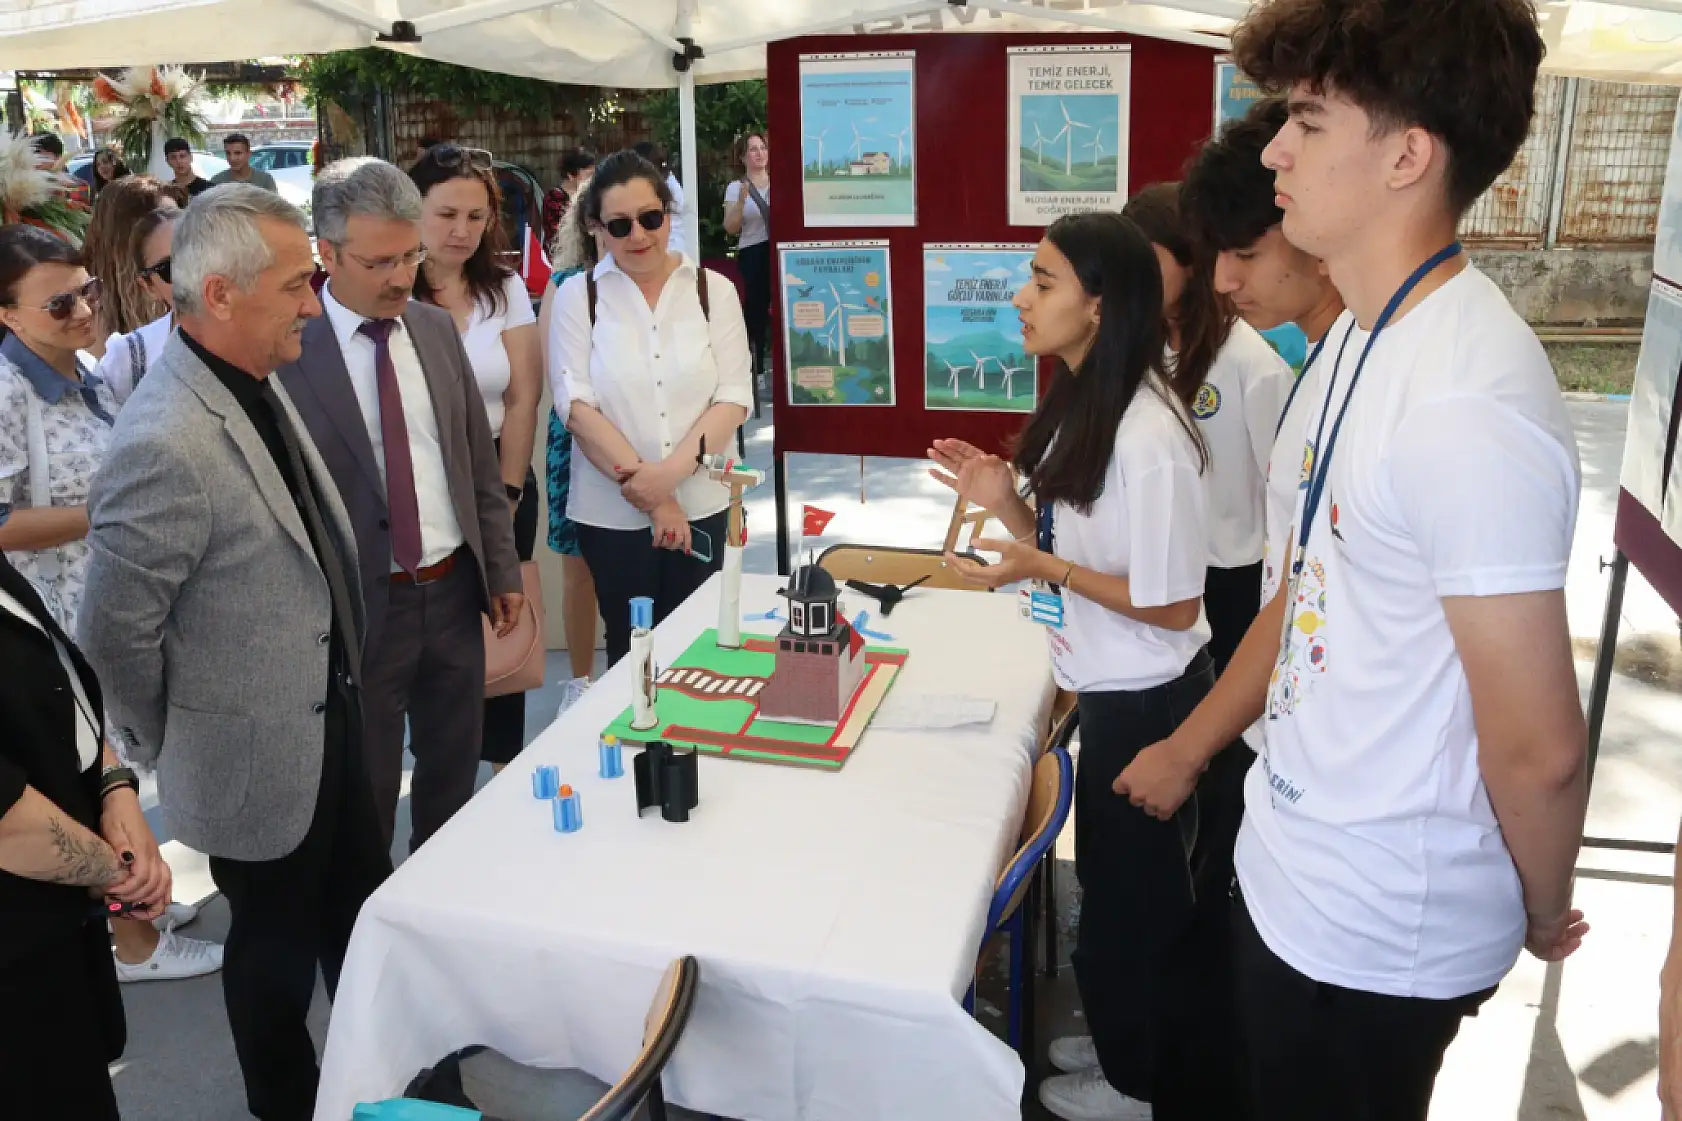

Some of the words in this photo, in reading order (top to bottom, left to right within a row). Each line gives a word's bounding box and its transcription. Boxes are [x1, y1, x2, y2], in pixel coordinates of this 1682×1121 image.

[1027, 64, 1062, 77] TEMİZ
[1028, 79, 1061, 90] TEMİZ
[1064, 79, 1113, 90] GELECEK
